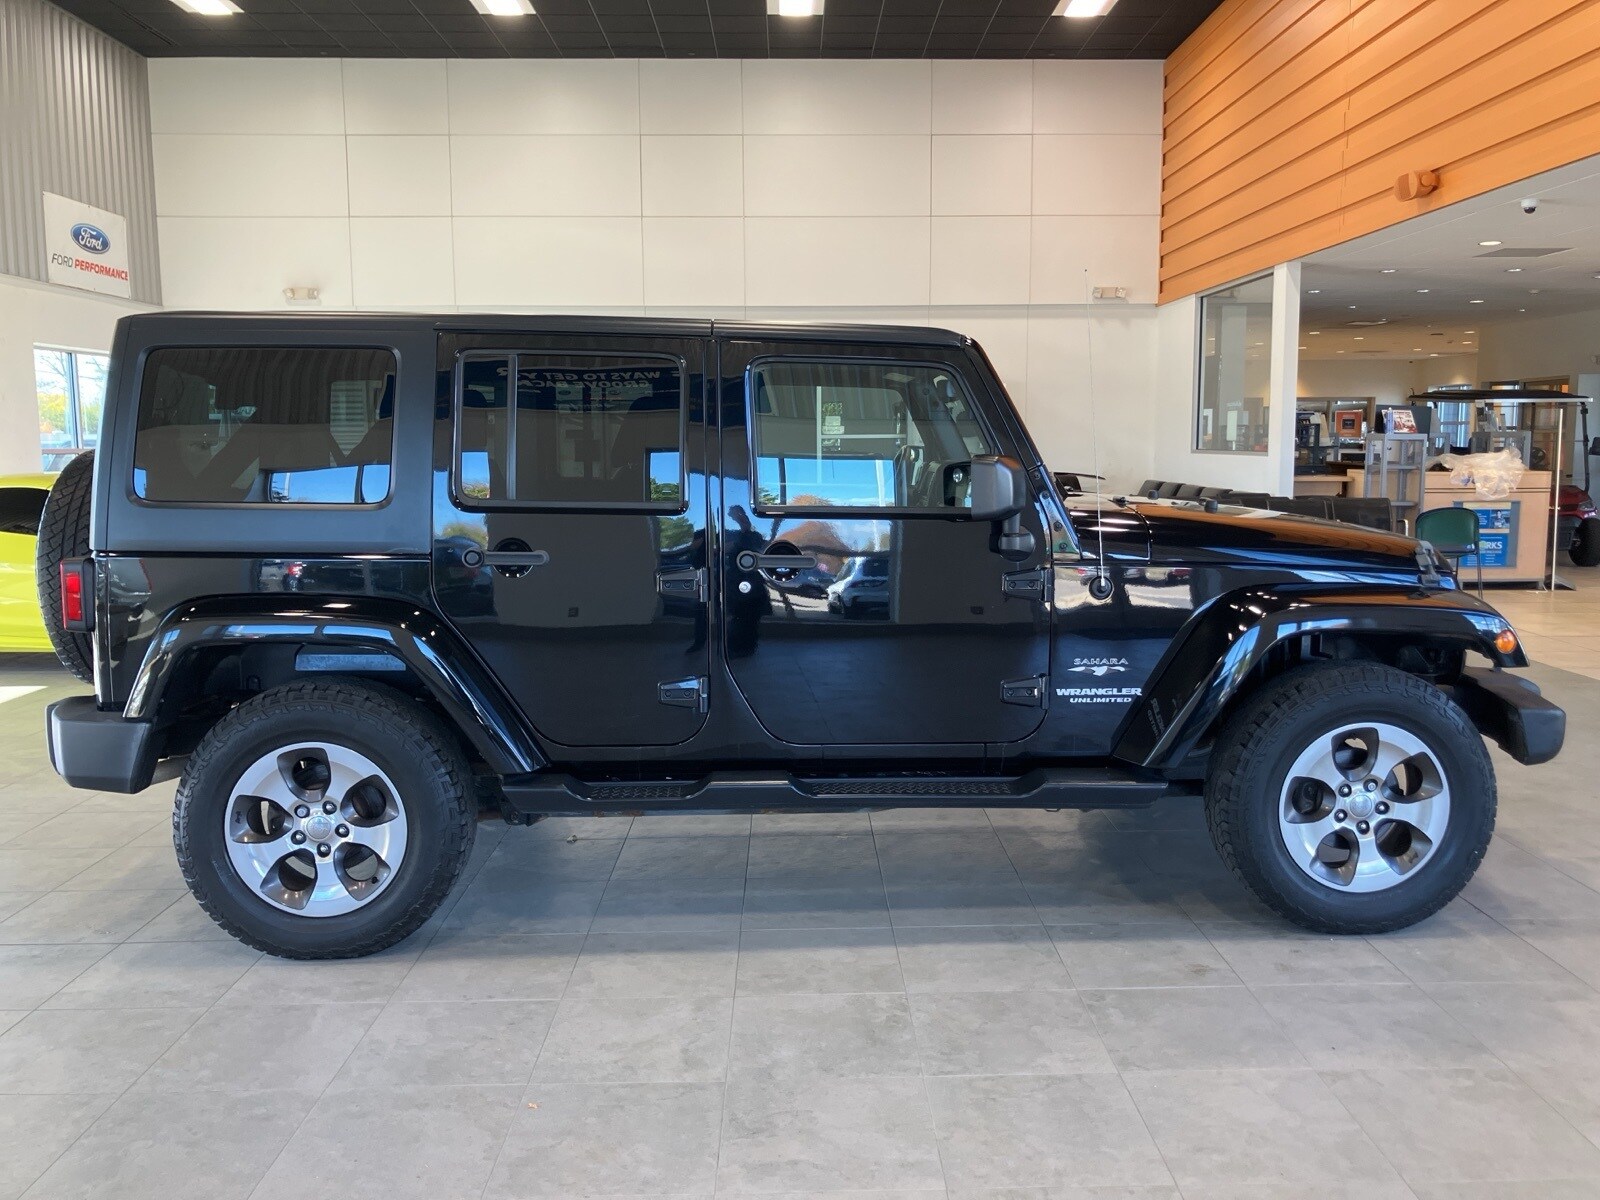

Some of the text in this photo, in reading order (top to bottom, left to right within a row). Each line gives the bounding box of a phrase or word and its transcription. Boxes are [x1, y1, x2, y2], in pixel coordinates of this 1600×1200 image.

[78, 227, 103, 250] Ford
[52, 253, 128, 281] FORD PERFORMANCE
[1073, 657, 1129, 665] SAHARA
[1056, 687, 1142, 696] WRANGLER
